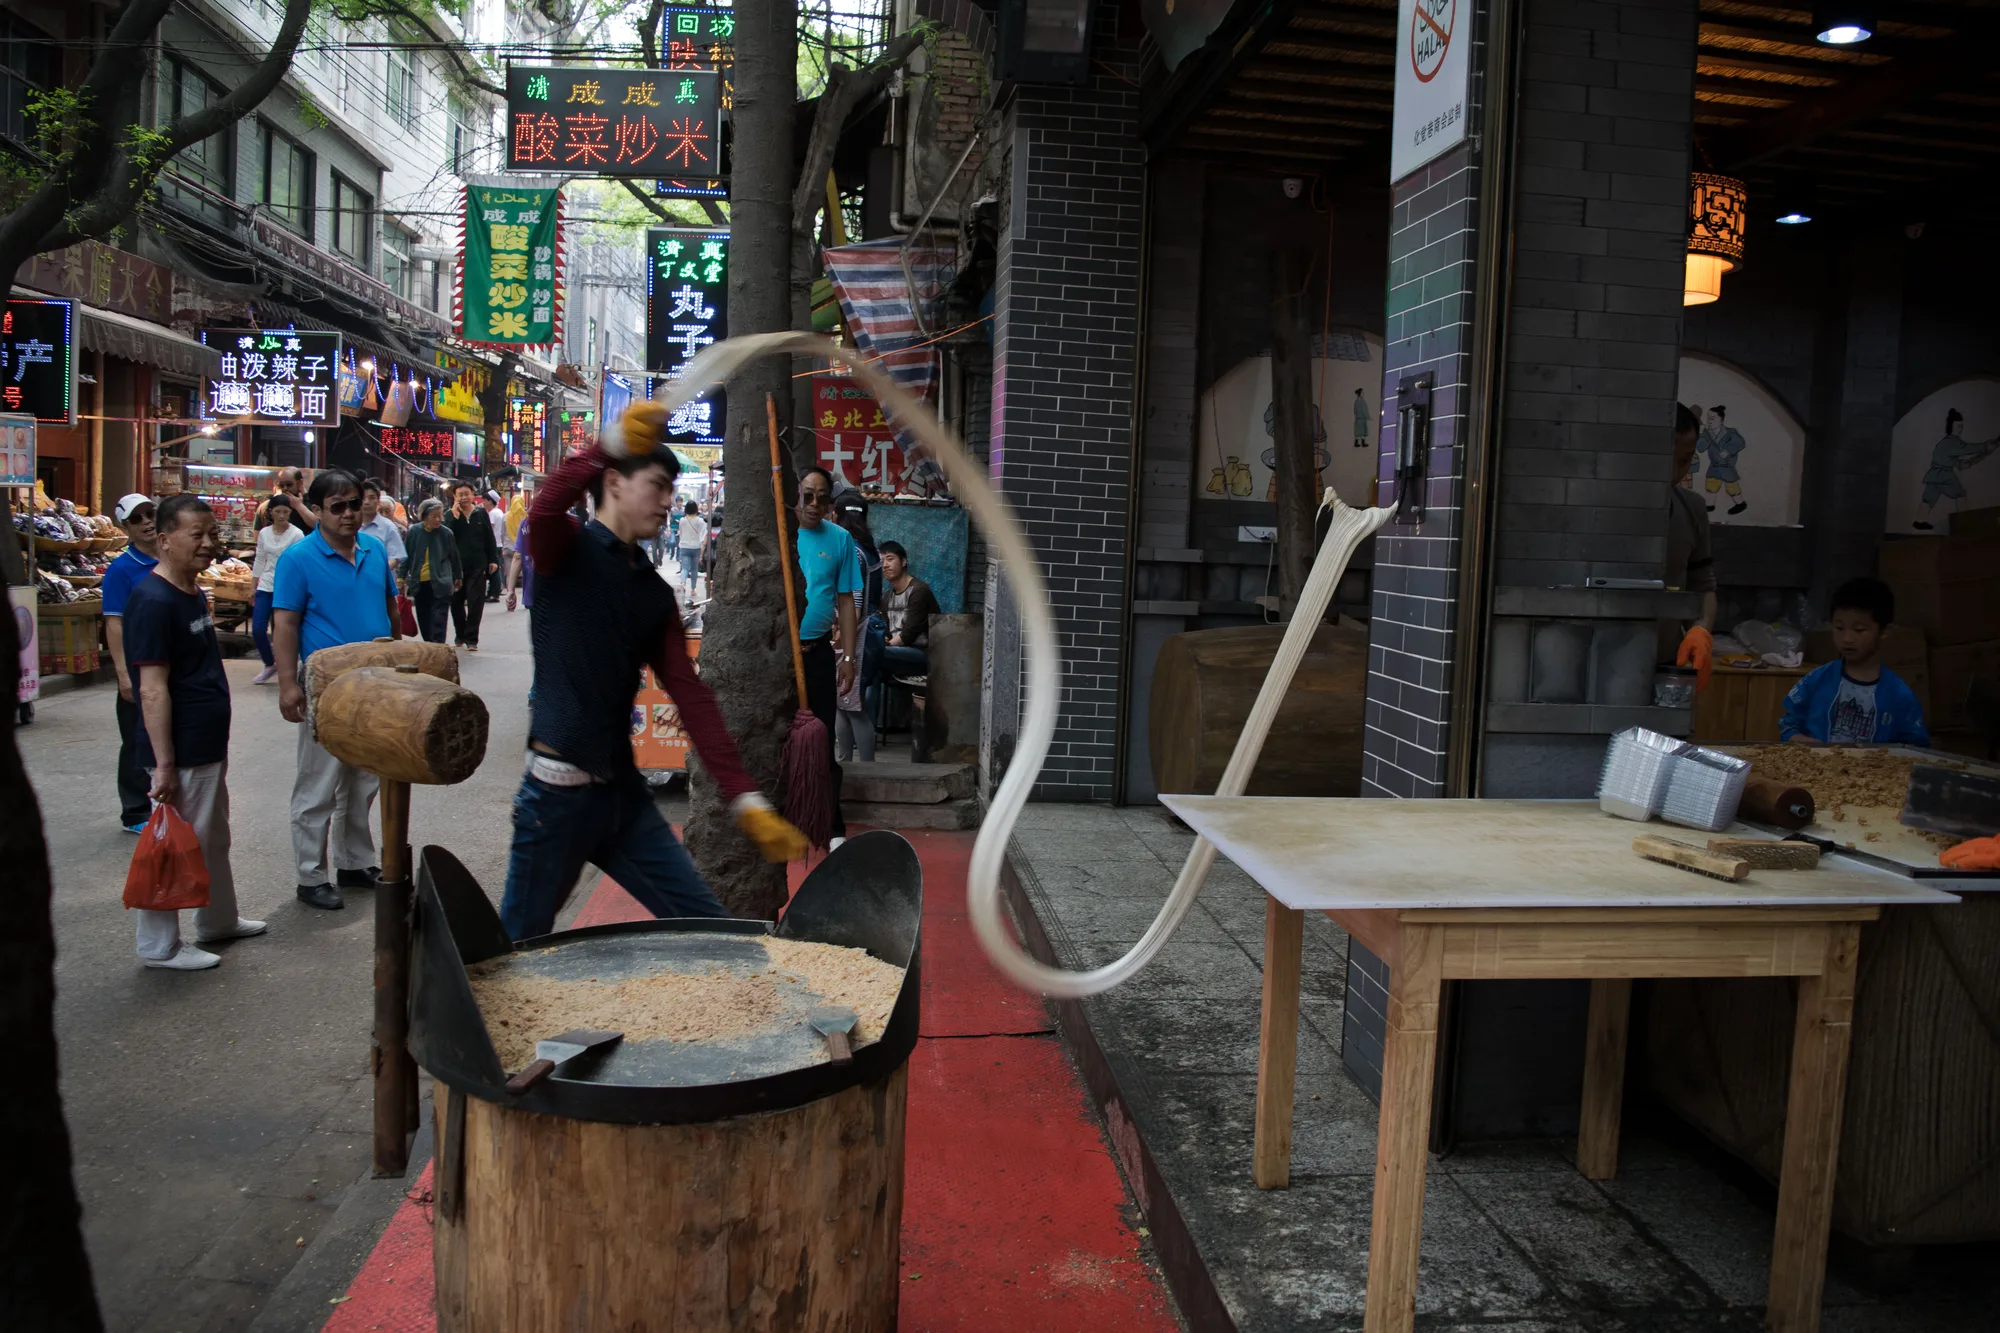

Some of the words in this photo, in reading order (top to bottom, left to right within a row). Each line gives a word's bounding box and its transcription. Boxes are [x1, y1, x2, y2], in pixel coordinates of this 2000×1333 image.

[677, 14, 735, 37] 回坊
[514, 112, 709, 168] 酸菜炒米
[488, 224, 529, 339] 酸菜炒米
[532, 246, 552, 324] 砂锅炒面
